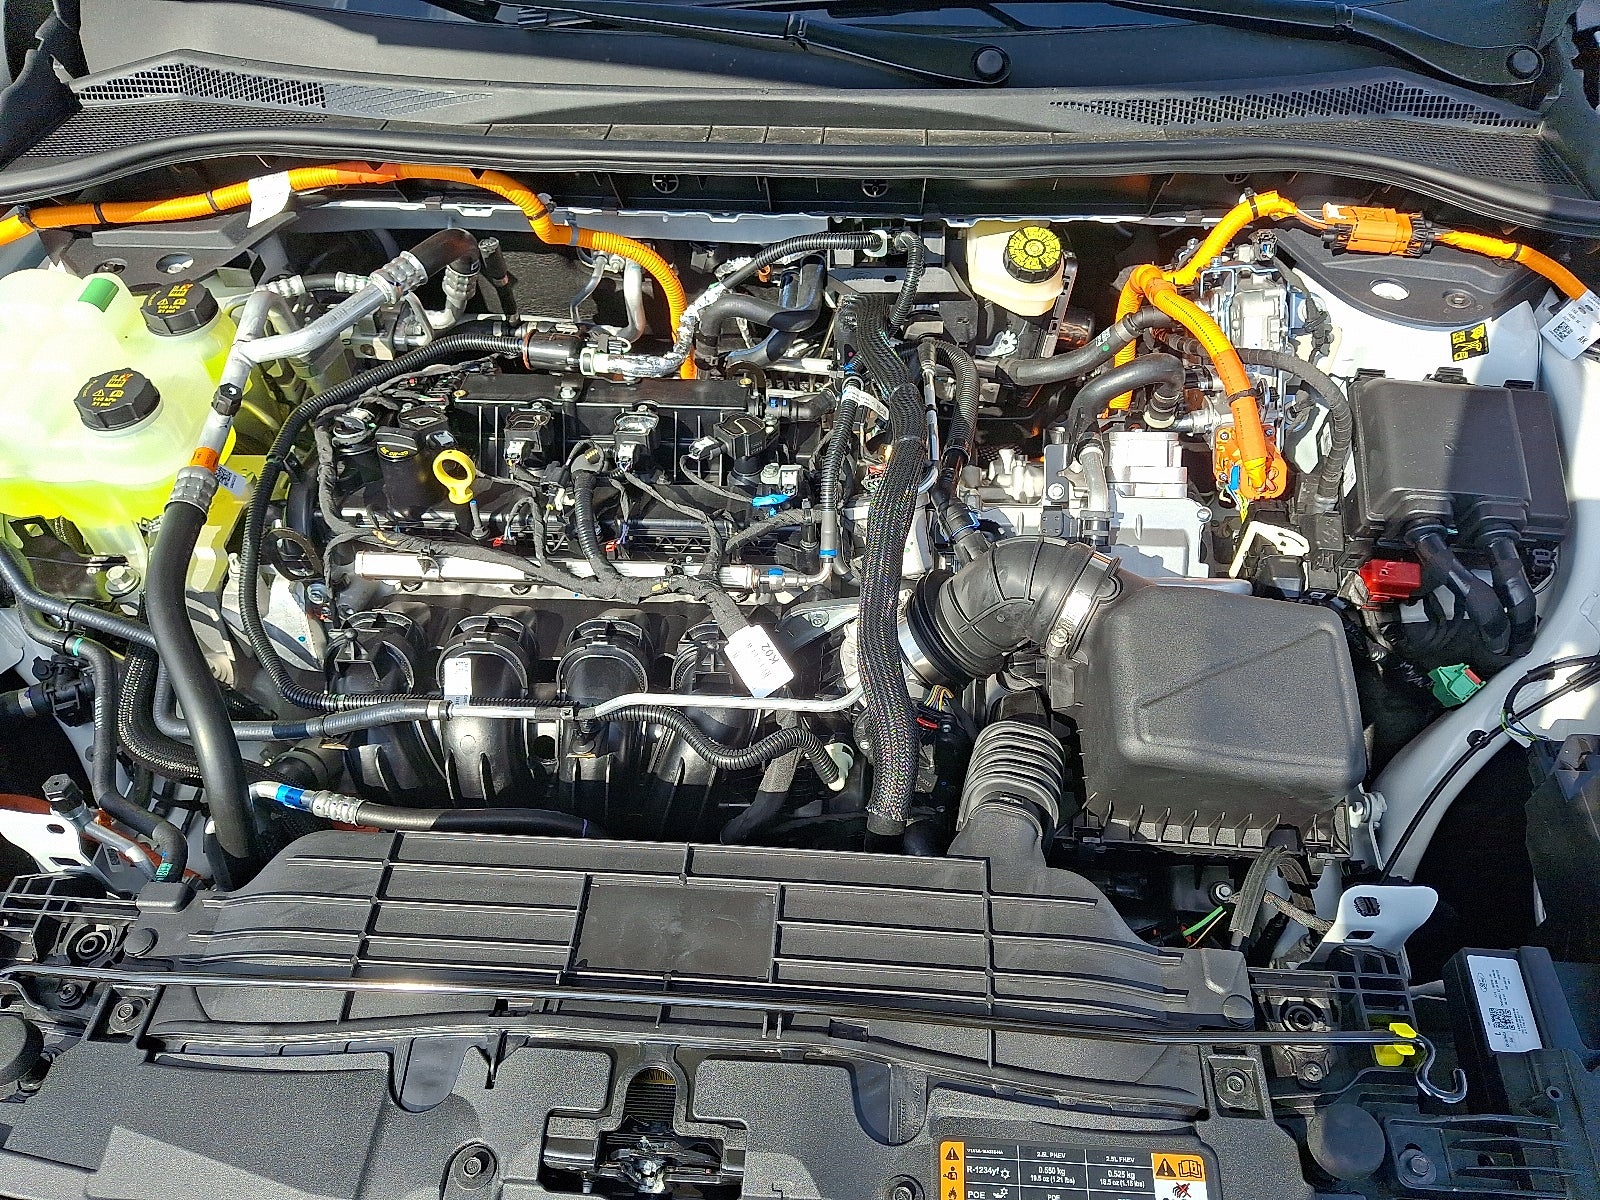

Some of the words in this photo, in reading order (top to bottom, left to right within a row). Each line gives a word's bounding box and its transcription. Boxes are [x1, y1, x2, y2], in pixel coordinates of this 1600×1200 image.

[966, 1165, 1000, 1177] R-1234yf
[1056, 1167, 1066, 1177] kg
[1107, 1169, 1126, 1179] 0.525
[1126, 1170, 1136, 1180] kg
[1100, 1178, 1112, 1186] 18.5
[967, 1190, 986, 1199] POE
